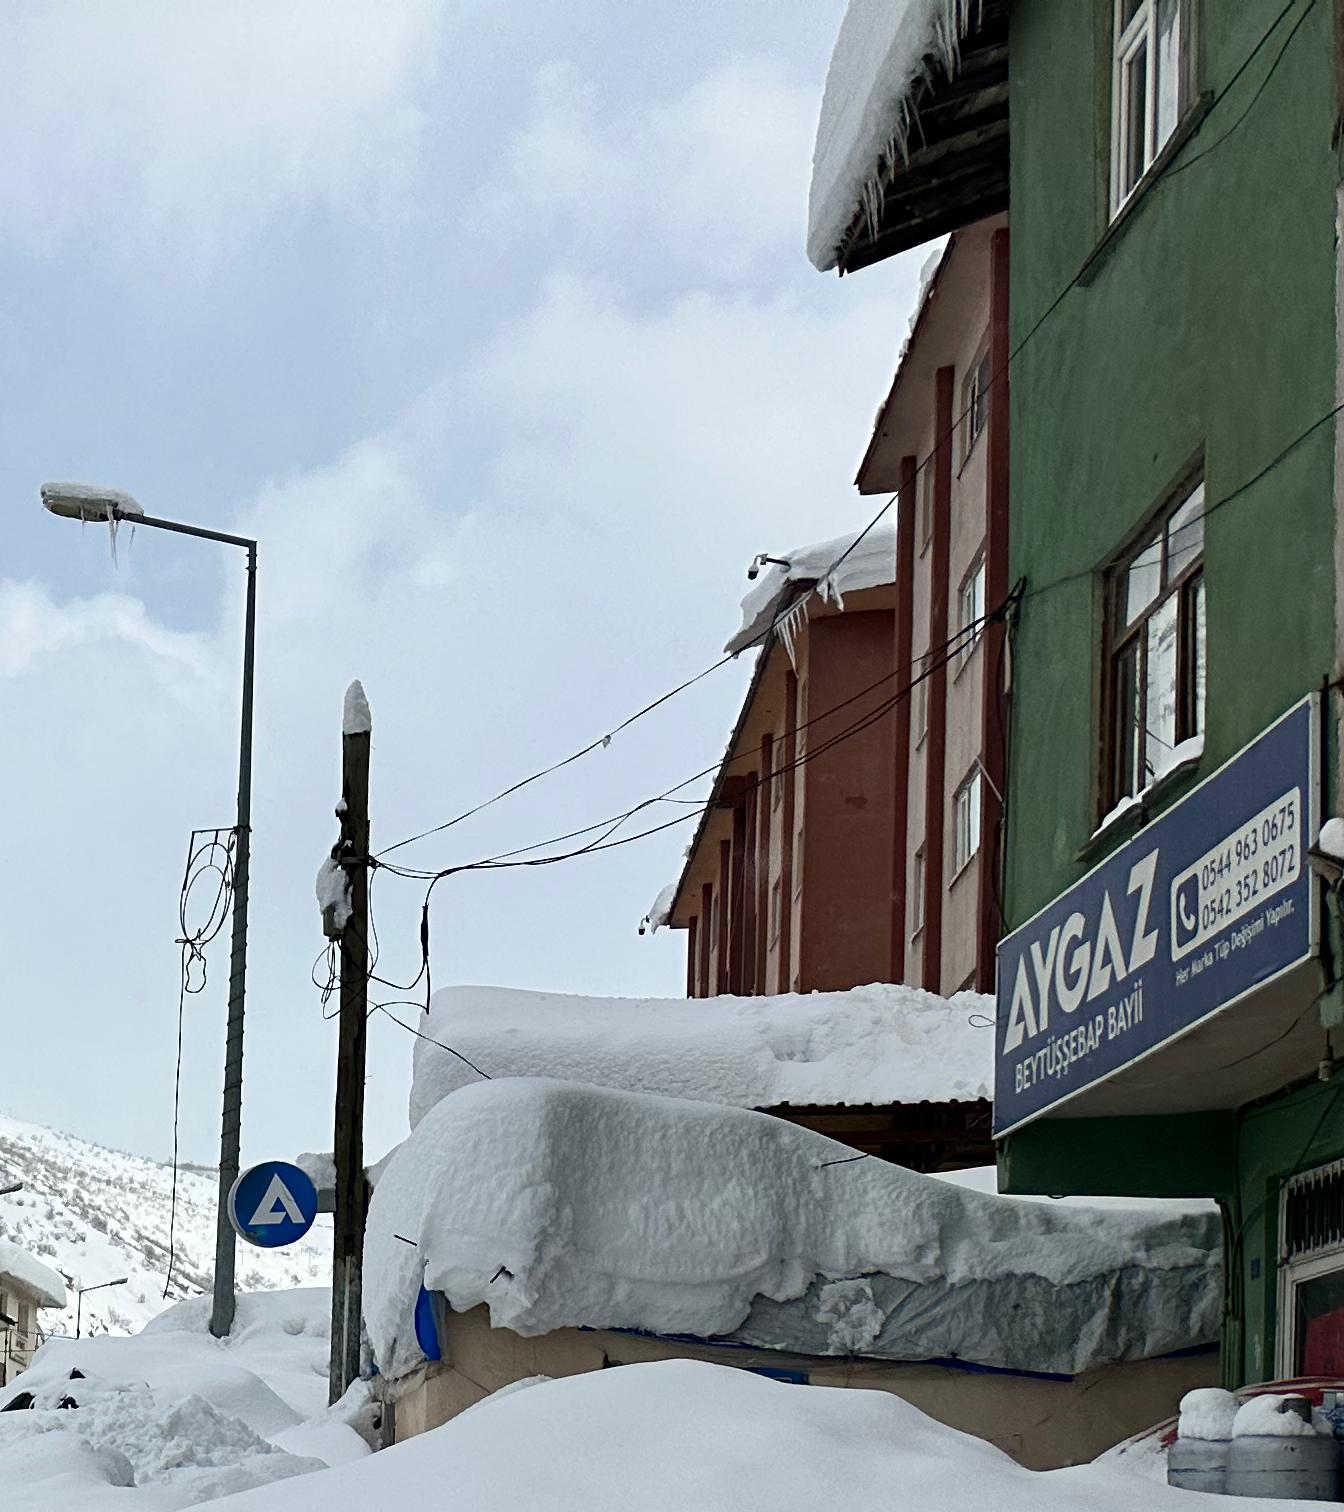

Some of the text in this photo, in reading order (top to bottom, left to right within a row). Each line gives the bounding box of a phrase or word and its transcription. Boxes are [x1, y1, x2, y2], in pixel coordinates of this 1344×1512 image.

[1201, 800, 1295, 891] 0544 963 0675
[1201, 843, 1295, 930] 0542 352 8072
[1003, 847, 1160, 1055] AYGAZ
[1015, 978, 1143, 1094] BEYTÜŞŞEBAP BAYİİ
